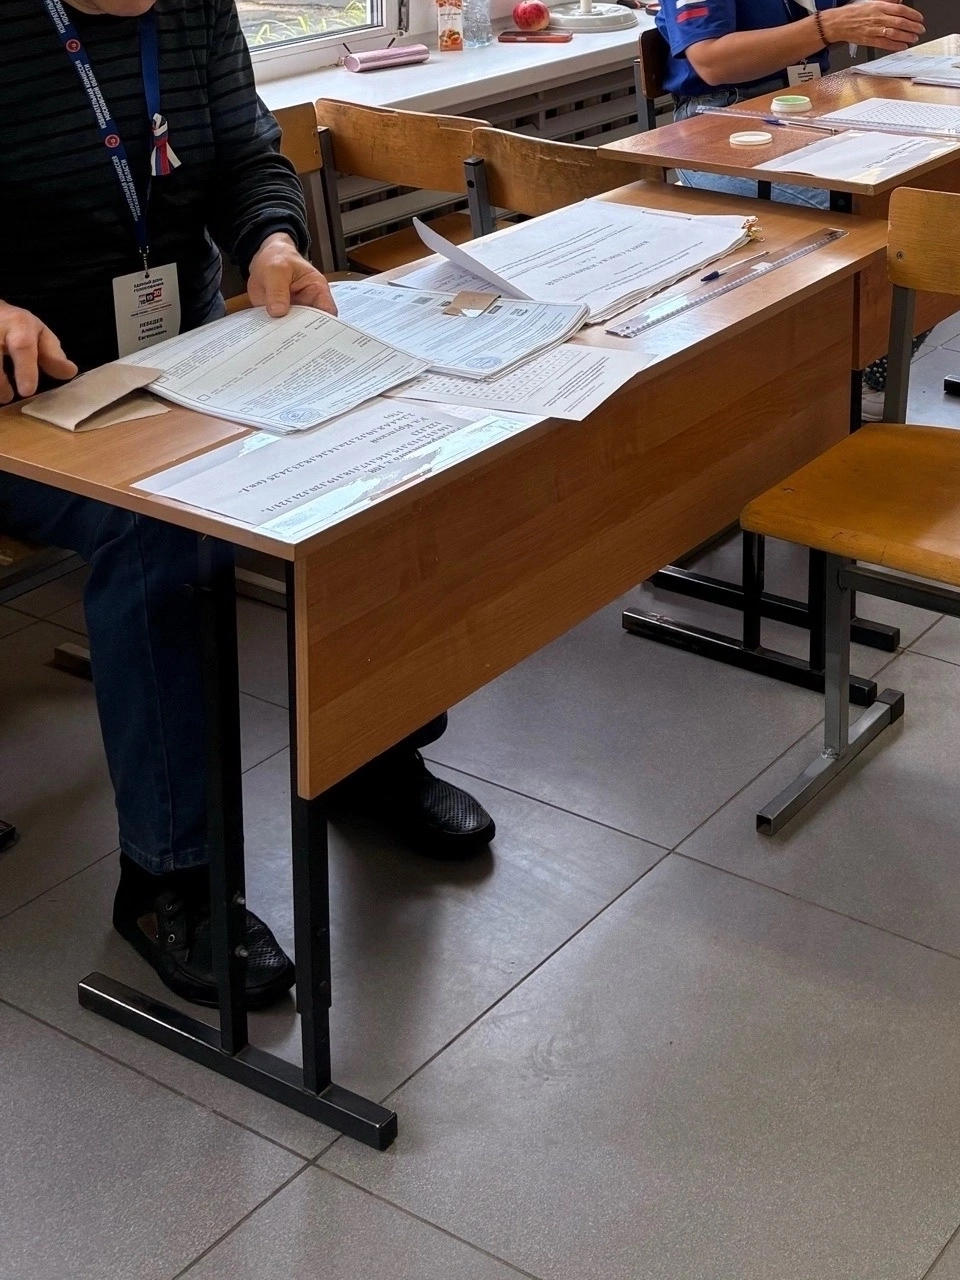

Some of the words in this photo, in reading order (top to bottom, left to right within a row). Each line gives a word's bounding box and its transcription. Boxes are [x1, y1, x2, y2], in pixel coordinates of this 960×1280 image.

[75, 60, 91, 89] КОМИССИЯ
[84, 63, 97, 88] ОБЛАСТИ
[87, 88, 107, 130] ИЗБИРАТЕЛЬНАЯ
[93, 86, 111, 122] МОСКОВСКОЙ
[112, 155, 126, 183] КОМИССИЯ
[121, 159, 133, 183] ОБЛАСТИ
[140, 318, 164, 328] ЛЕБЕДЕВ
